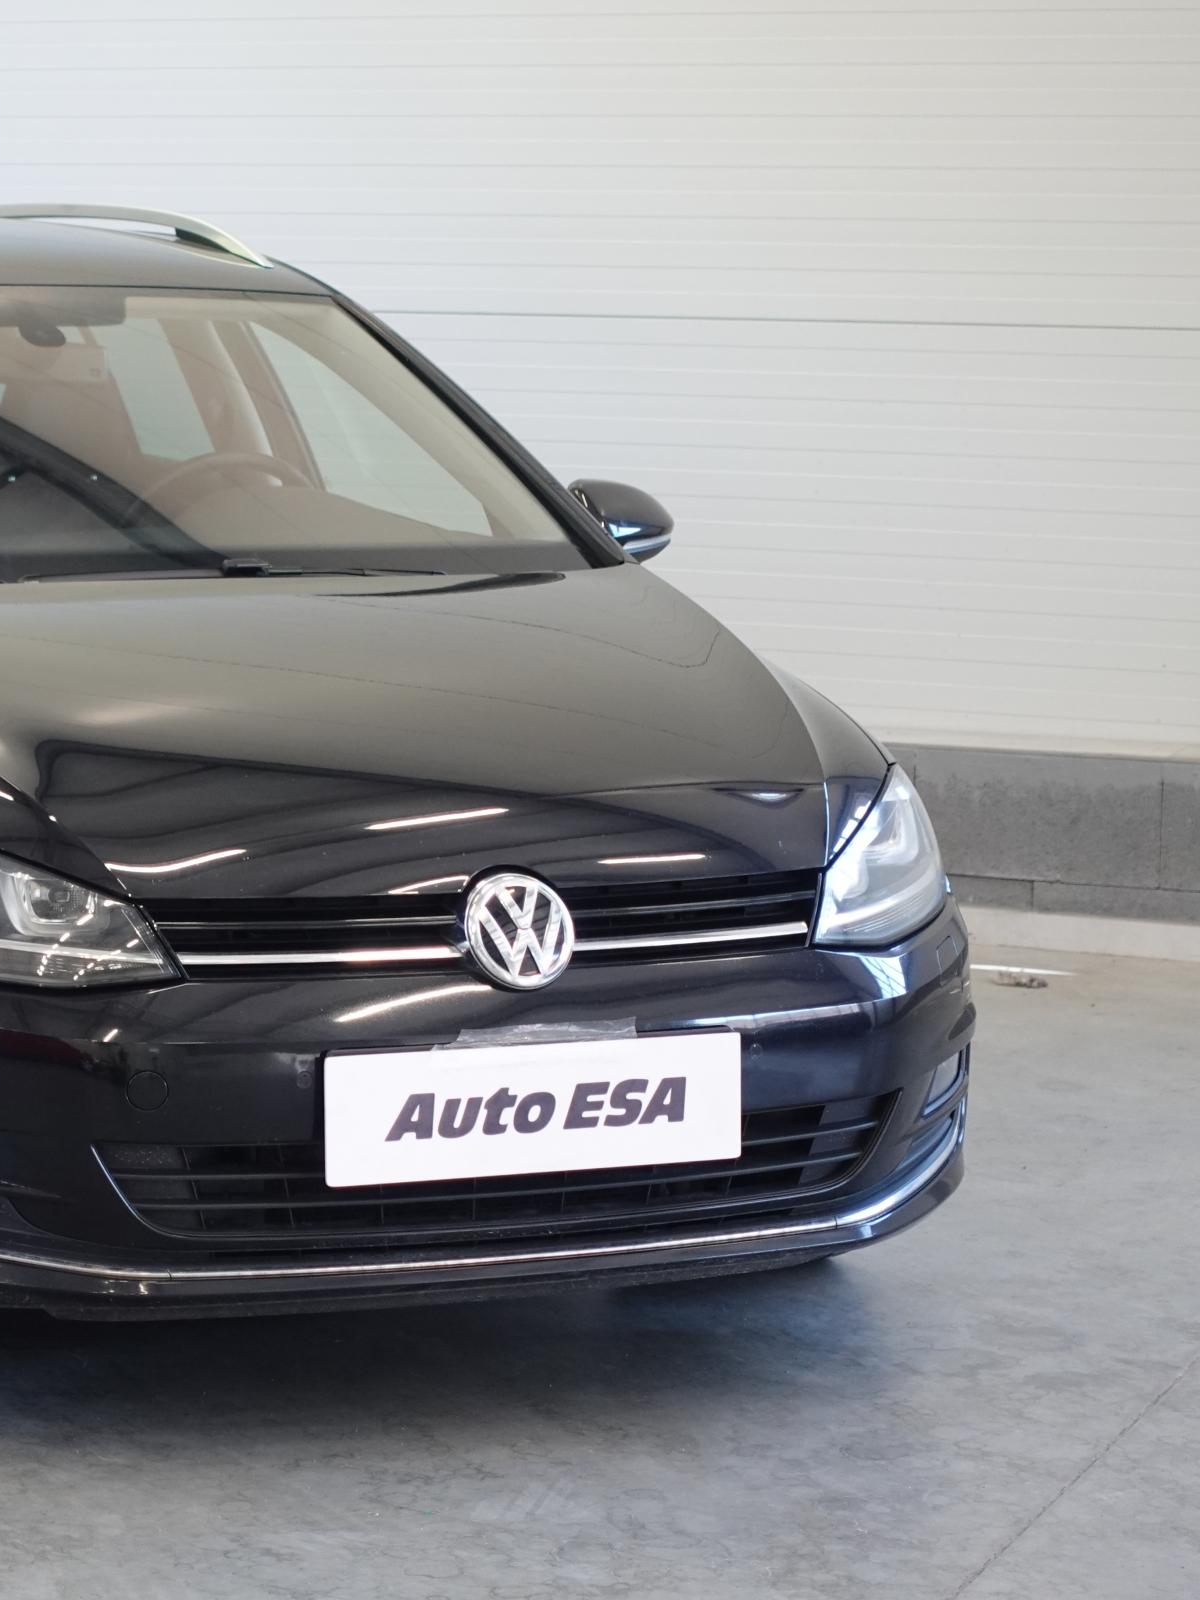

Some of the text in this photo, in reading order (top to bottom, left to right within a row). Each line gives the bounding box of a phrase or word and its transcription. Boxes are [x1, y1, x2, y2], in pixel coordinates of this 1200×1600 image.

[471, 877, 569, 985] VW
[385, 1076, 687, 1142] Auto ESA
